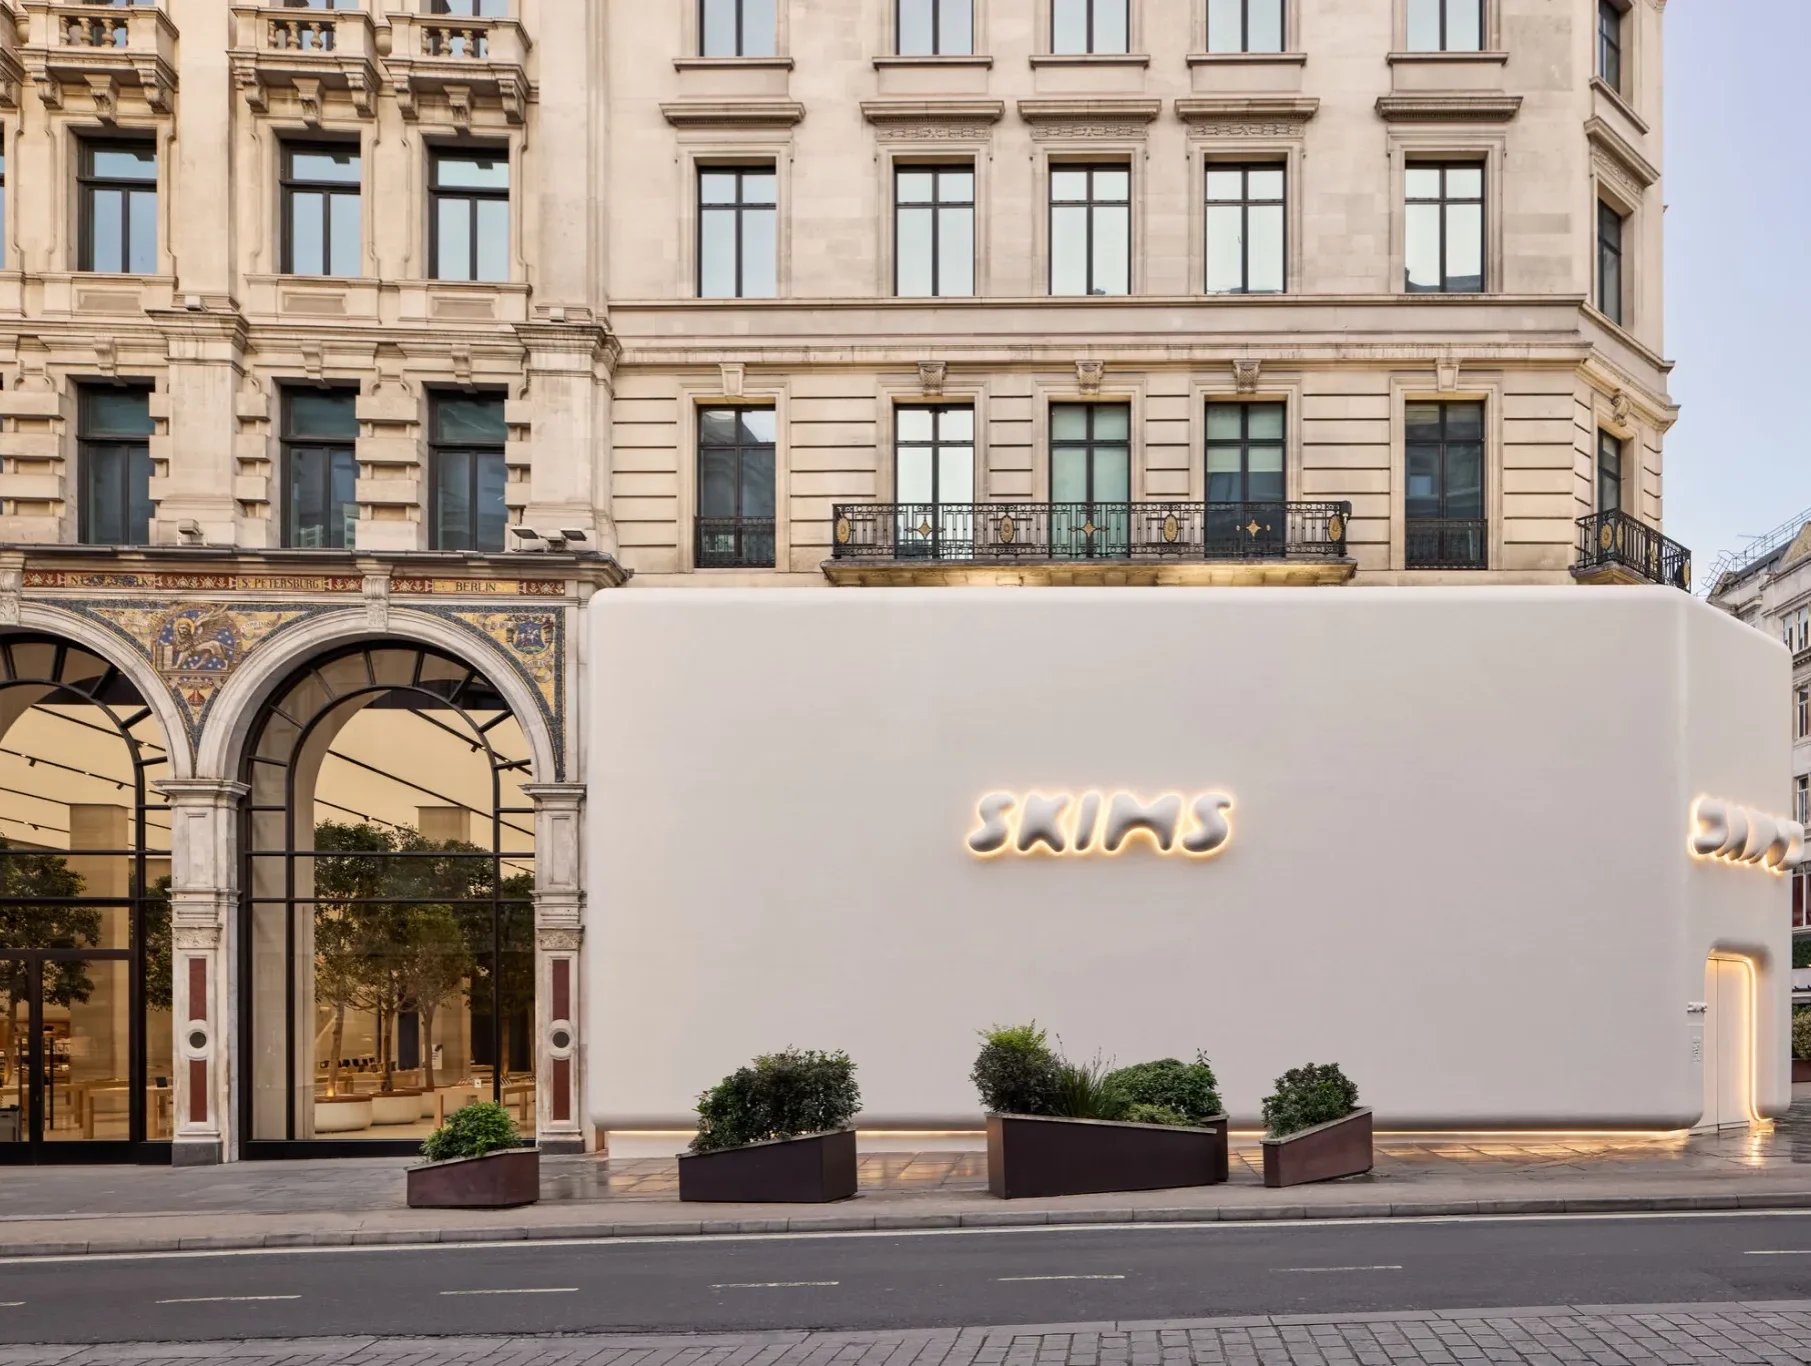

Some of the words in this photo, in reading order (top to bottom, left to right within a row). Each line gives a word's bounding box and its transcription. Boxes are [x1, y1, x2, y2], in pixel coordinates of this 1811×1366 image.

[254, 578, 319, 590] PETERSBURG
[456, 581, 496, 592] BERLIN
[968, 792, 1232, 853] SKIMS
